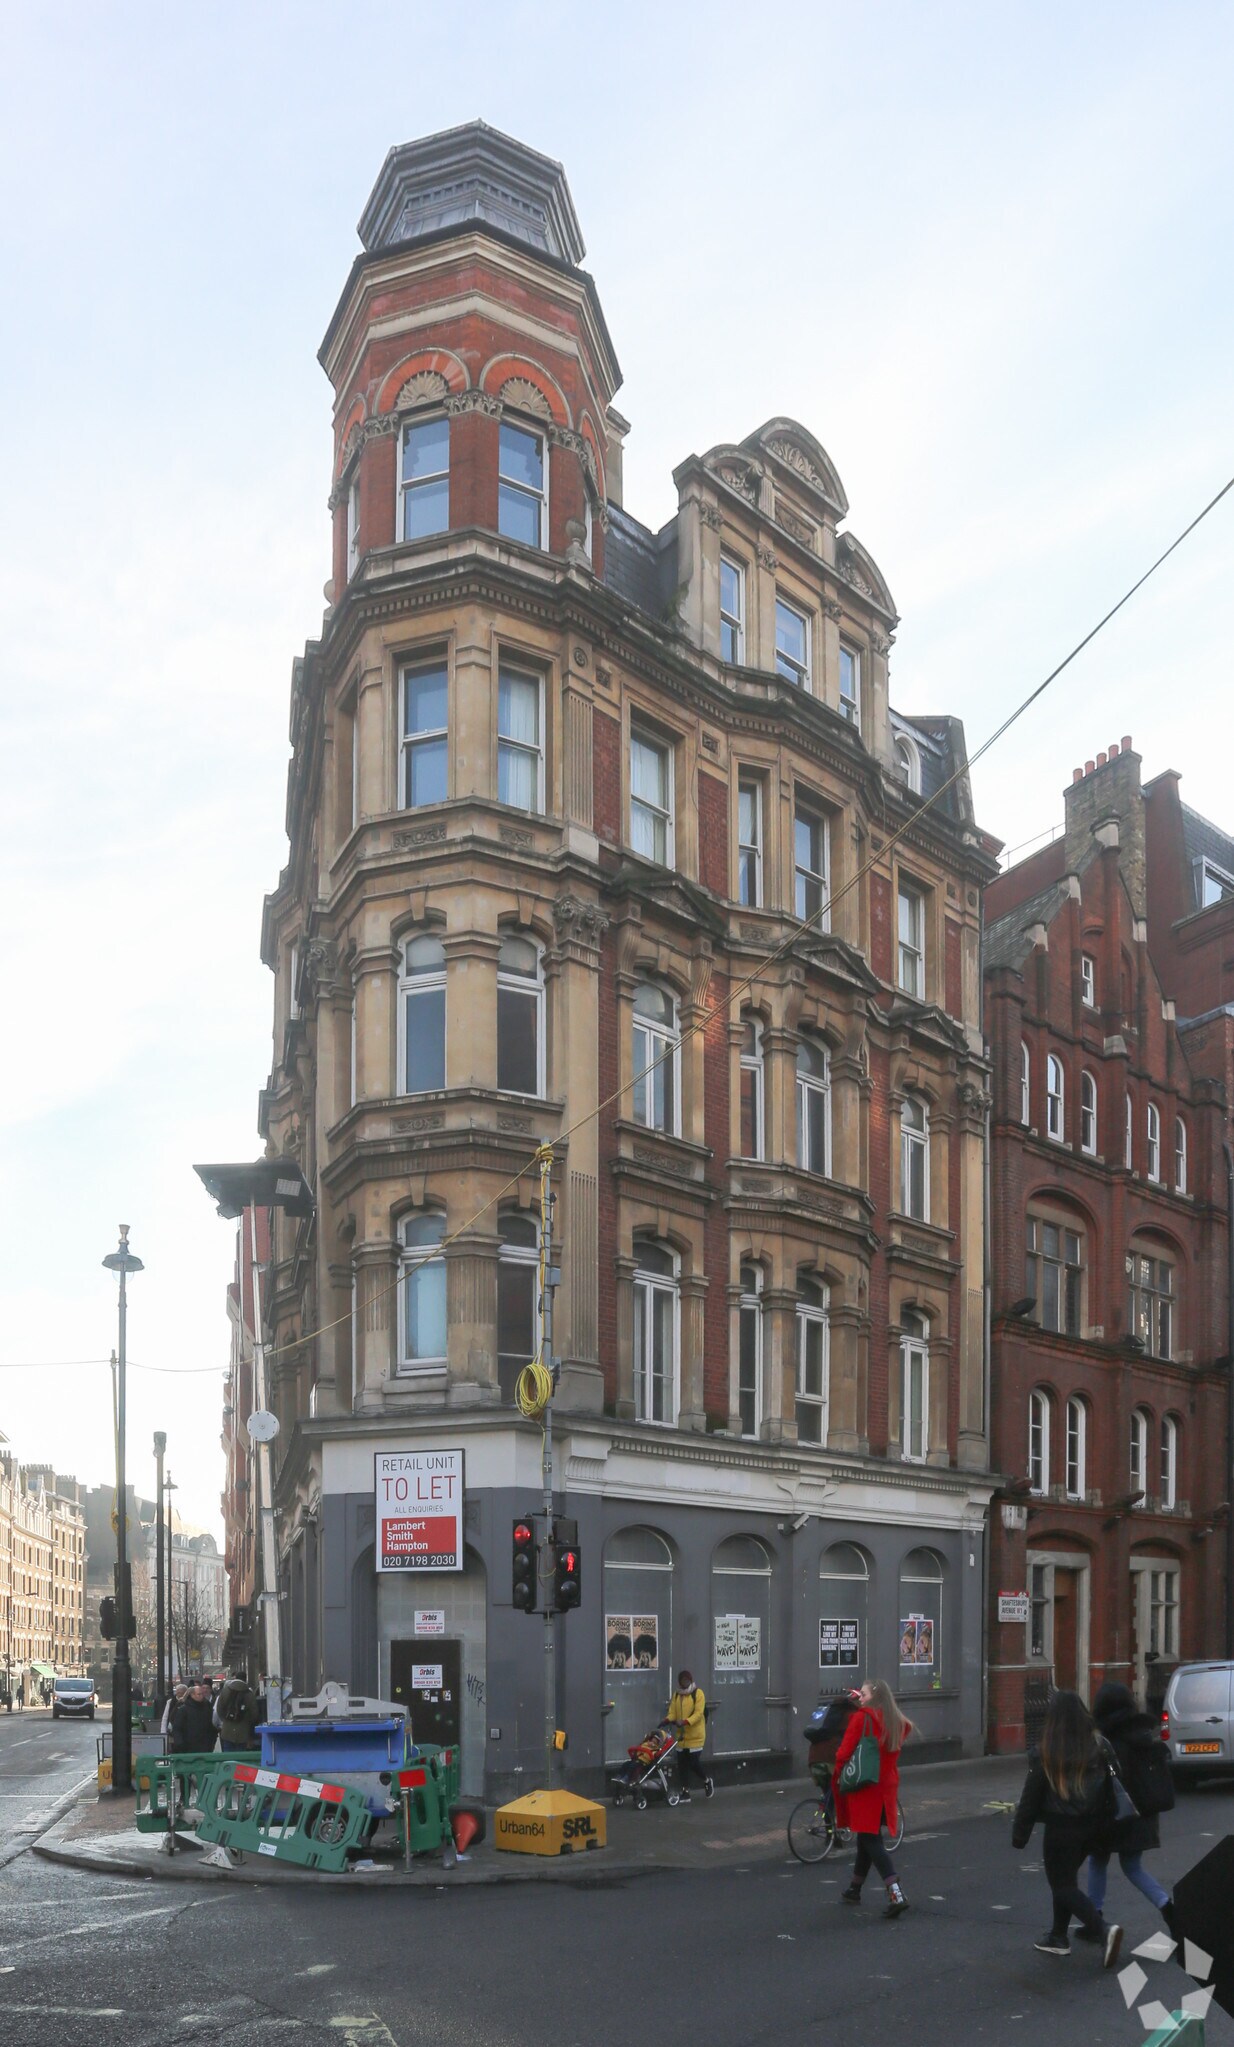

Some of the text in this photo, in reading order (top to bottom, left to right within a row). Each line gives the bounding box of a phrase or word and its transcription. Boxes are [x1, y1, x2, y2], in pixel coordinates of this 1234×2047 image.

[382, 1456, 455, 1472] RETAIL UNIT
[381, 1475, 457, 1501] TO LET
[394, 1504, 444, 1514] ALL ENQUIRIES
[386, 1521, 426, 1531] Lambert
[386, 1531, 413, 1541] Smith
[386, 1541, 428, 1552] Hampton
[383, 1554, 455, 1567] 020 7198 2030
[717, 1643, 736, 1657] WAVEY
[740, 1643, 758, 1657] WAVEY
[499, 1819, 545, 1837] Urban64
[562, 1815, 597, 1839] SRL
